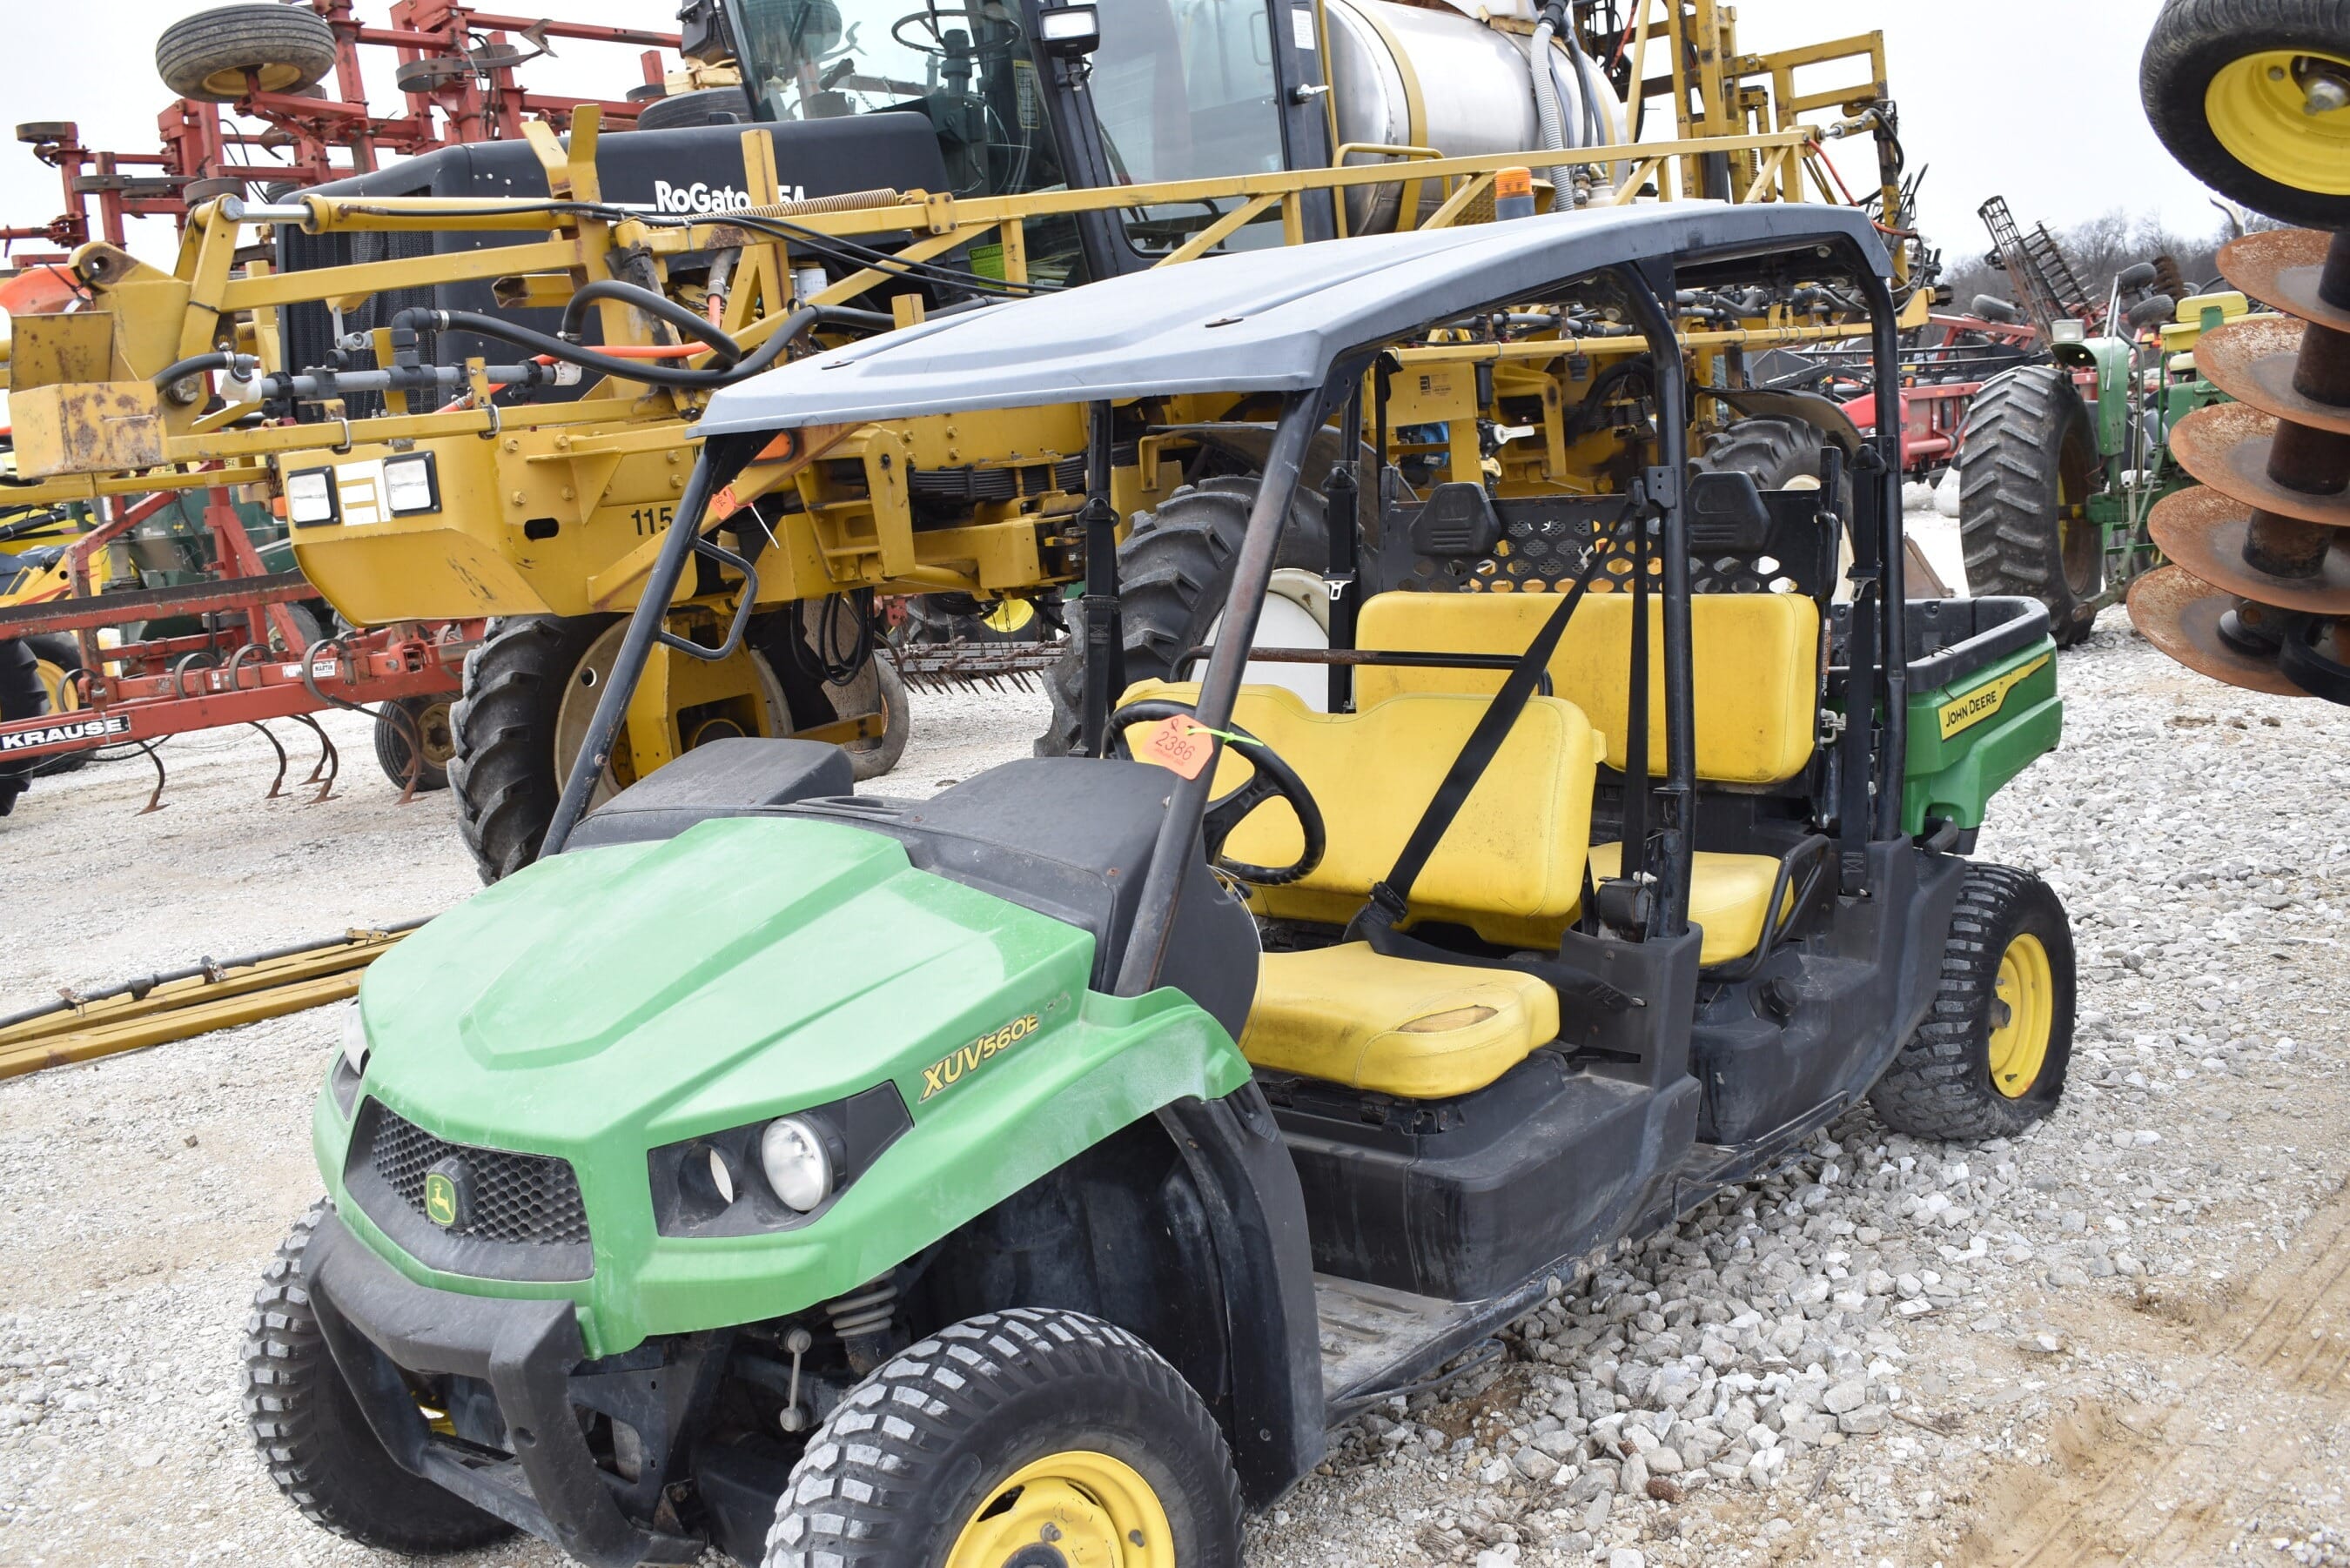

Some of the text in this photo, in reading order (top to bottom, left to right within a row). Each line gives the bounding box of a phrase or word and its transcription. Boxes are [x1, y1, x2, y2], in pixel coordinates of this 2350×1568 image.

[655, 180, 805, 212] RoGato 54
[1945, 691, 1997, 727] JOHN DEERE
[2, 719, 122, 748] KRAUSE
[1156, 731, 1195, 760] 2386
[919, 1015, 1038, 1102] XUV560E
